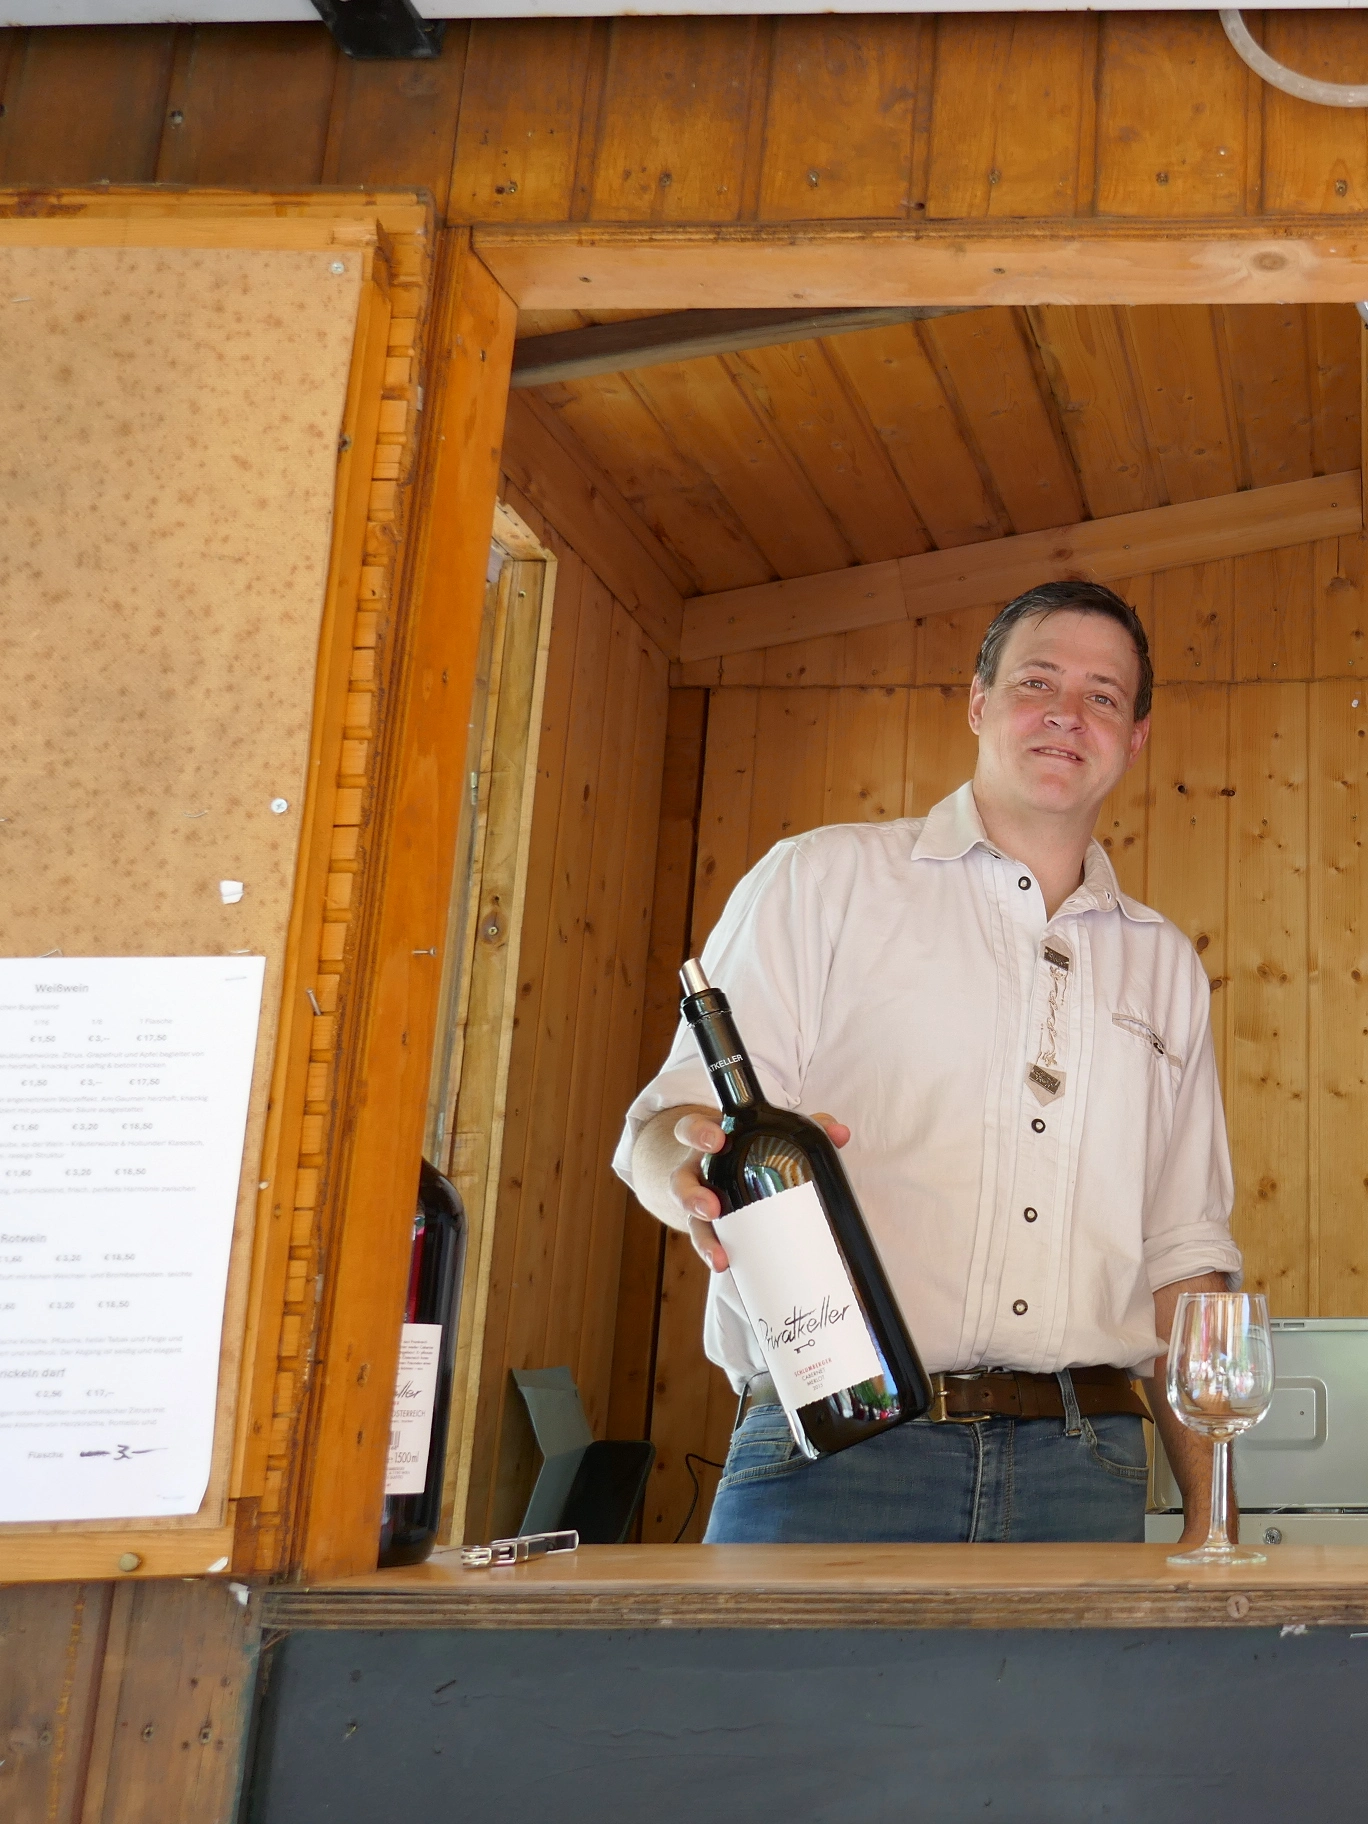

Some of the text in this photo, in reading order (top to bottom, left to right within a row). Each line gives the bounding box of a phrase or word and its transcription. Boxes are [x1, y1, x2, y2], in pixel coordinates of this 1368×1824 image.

[35, 983, 89, 993] Weißwein
[1, 1233, 47, 1243] Rotwein
[758, 1294, 852, 1352] Privatkeller
[794, 1357, 833, 1378] SCHLUMBERGER
[801, 1368, 826, 1382] CABERNET
[807, 1375, 826, 1387] MERLOT
